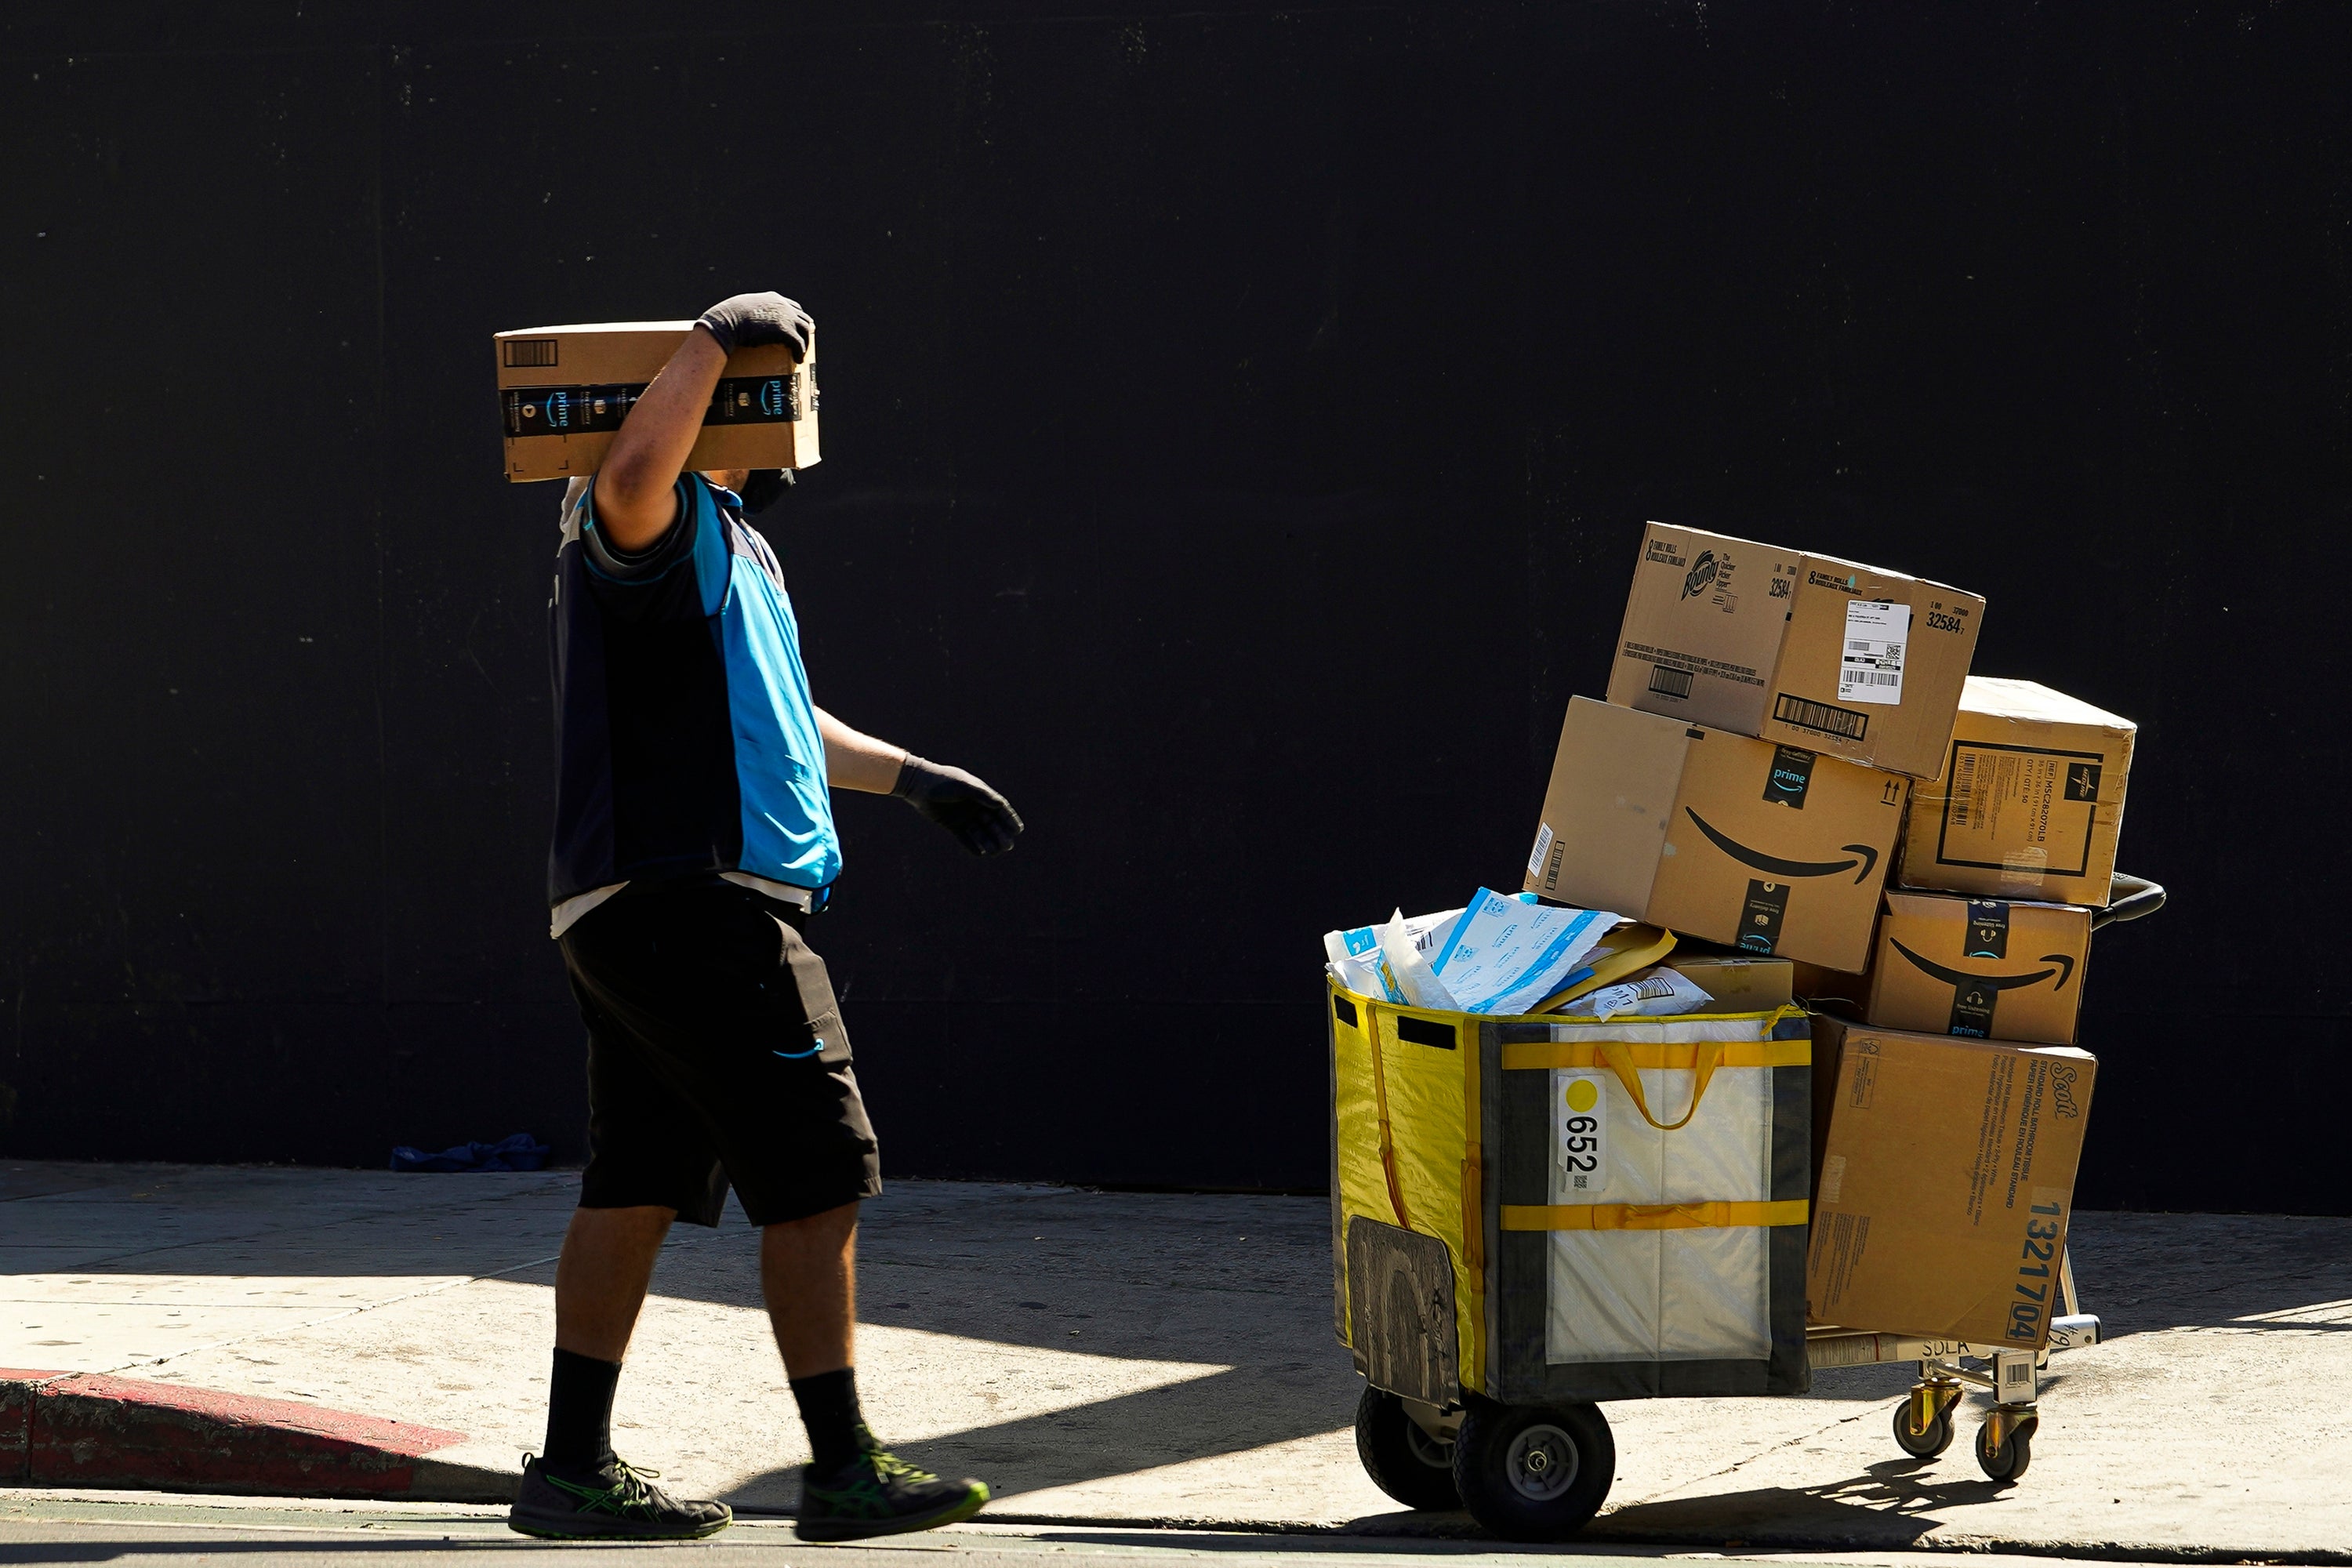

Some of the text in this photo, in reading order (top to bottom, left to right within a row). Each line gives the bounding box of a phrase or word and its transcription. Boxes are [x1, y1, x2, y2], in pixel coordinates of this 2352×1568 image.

[555, 392, 570, 426] prime
[769, 380, 785, 415] prime
[1646, 539, 1654, 561] 8
[1681, 558, 1722, 601] Bounty
[1808, 570, 1816, 586] 8
[1926, 611, 1962, 634] 32584
[1773, 766, 1806, 784] prime
[2078, 767, 2088, 797] MEDLINE
[2021, 794, 2027, 803] 50
[2037, 780, 2052, 842] MSC282070LB
[1951, 1023, 1984, 1037] prime
[2005, 1056, 2016, 1083] Standard
[2027, 1058, 2038, 1083] PAPIER
[2050, 1062, 2078, 1120] Scott
[1999, 1096, 2009, 1124] Bathroom
[2020, 1060, 2048, 1181] STANDARD ROLL BATHROOM TISSUE
[1566, 1116, 1598, 1172] 652
[1995, 1125, 2004, 1144] Tissue
[2017, 1127, 2026, 1137] EN
[2012, 1138, 2024, 1171] ROULEAU
[2005, 1171, 2018, 1208] STANDARD
